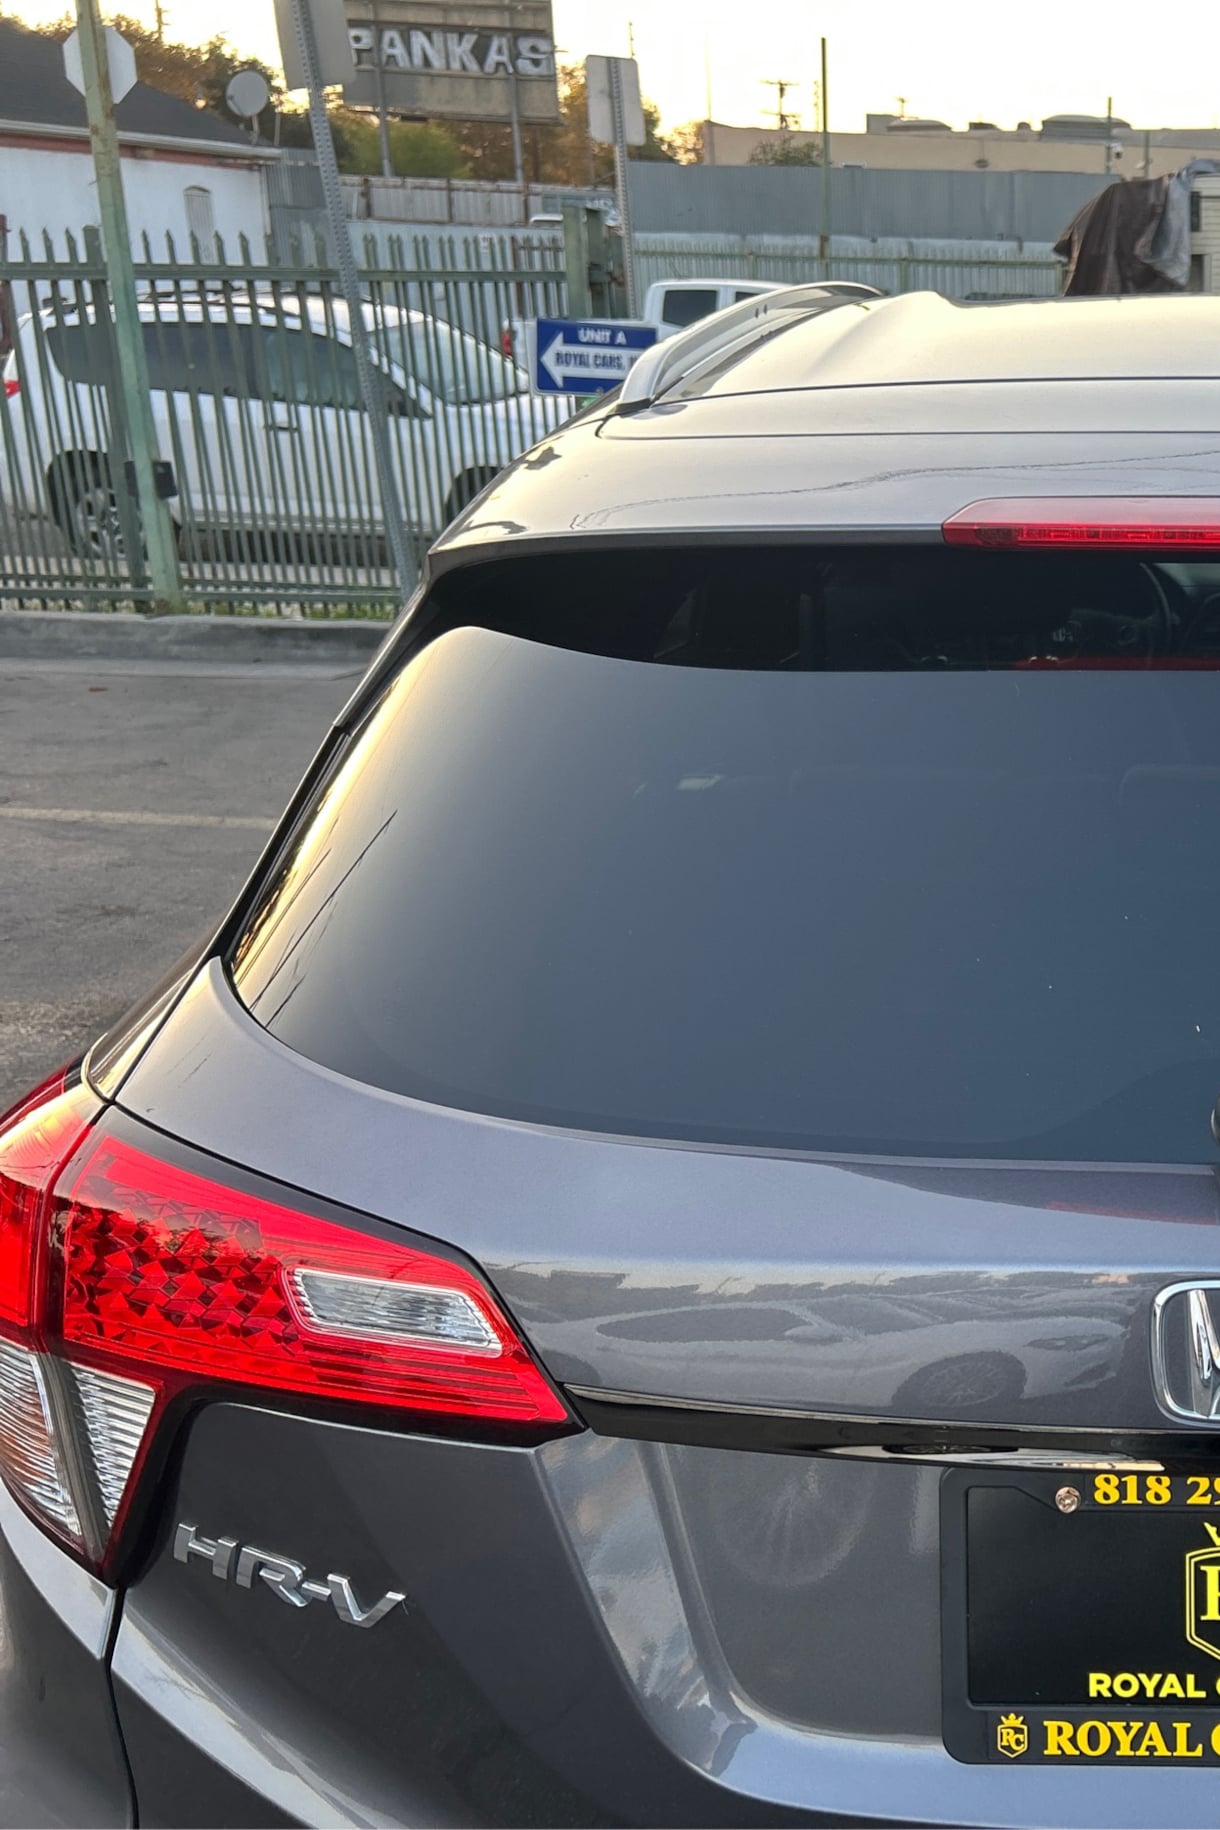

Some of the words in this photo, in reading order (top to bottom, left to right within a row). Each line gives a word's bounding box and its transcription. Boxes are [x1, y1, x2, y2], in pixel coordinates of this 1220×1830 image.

[347, 27, 553, 76] PANKAS
[578, 327, 611, 344] UNIT
[614, 330, 627, 345] A
[555, 350, 590, 368] ROYAL
[1094, 1474, 1172, 1505] 818
[173, 1521, 406, 1628] HR-V
[1088, 1673, 1207, 1698] ROYAL
[1000, 1728, 1025, 1751] RC
[1043, 1720, 1203, 1757] ROYAL
